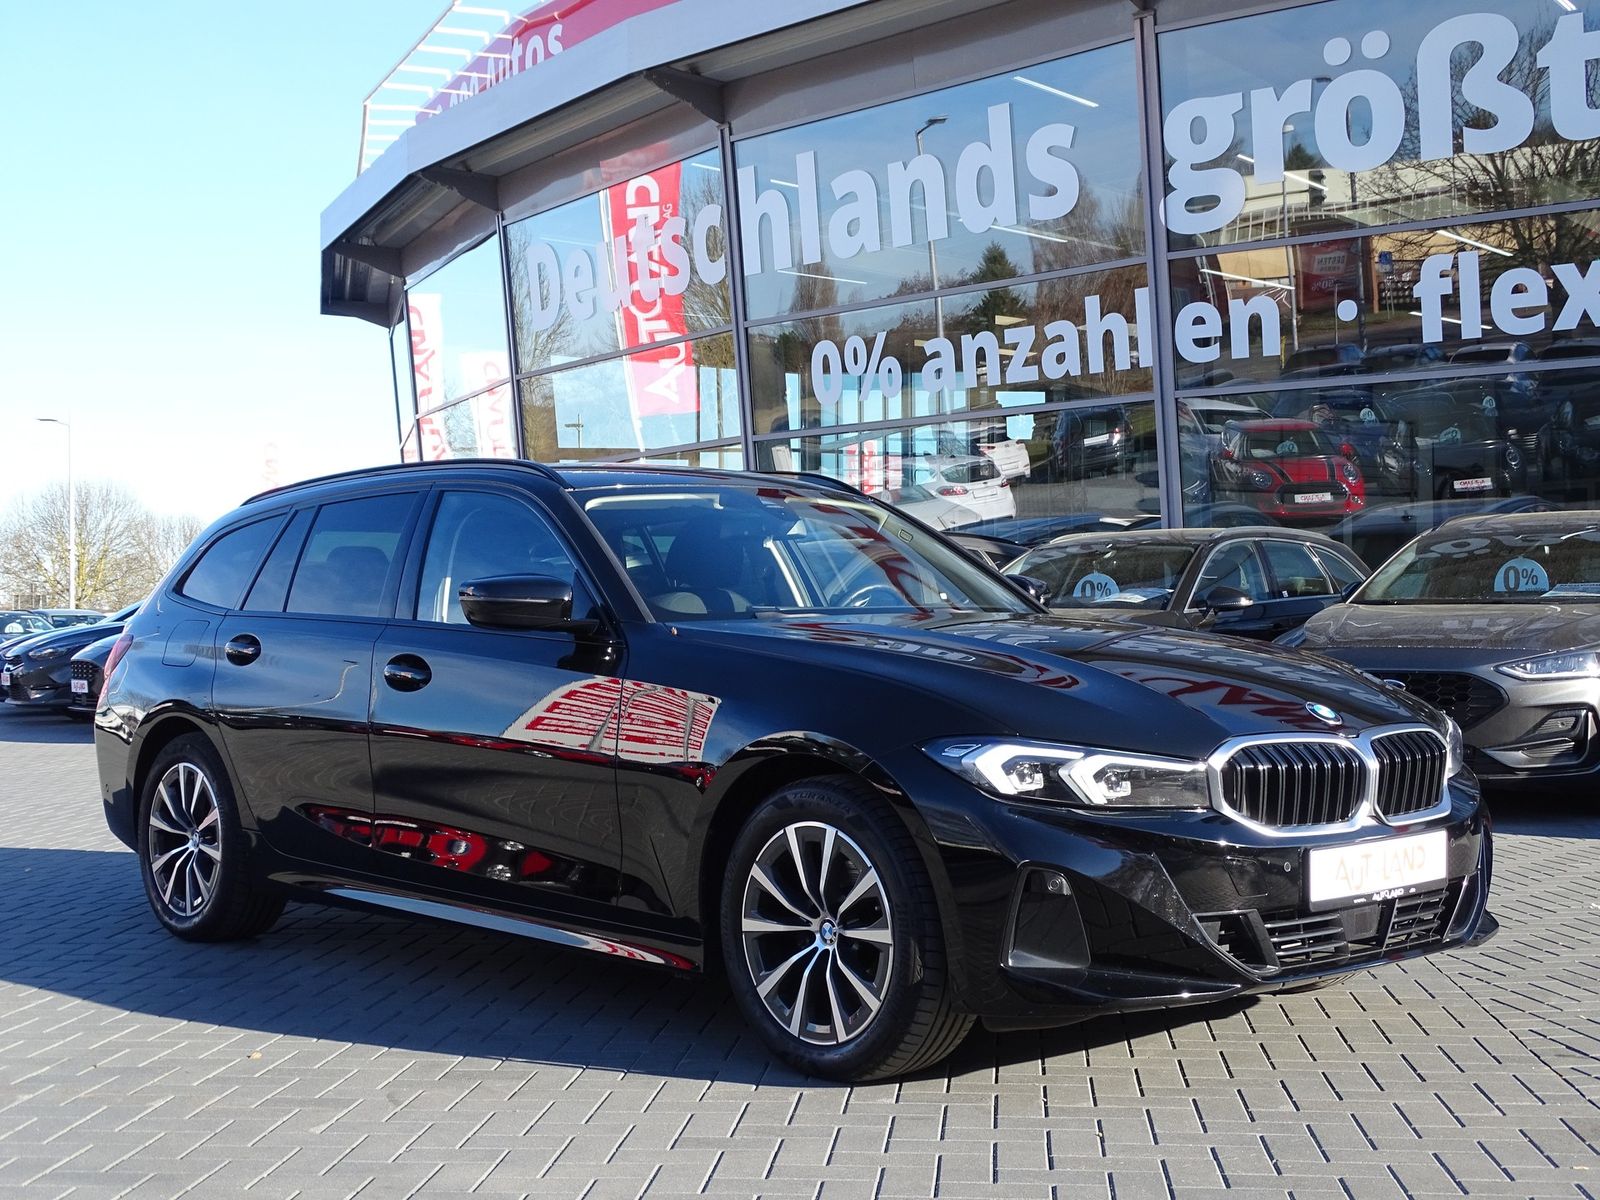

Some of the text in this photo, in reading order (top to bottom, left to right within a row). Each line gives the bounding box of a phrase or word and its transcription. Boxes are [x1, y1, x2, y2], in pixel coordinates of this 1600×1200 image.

[527, 12, 1600, 331] Deutschlands größt
[811, 250, 1600, 408] 0% anzahlen flex
[1503, 565, 1539, 592] 0%
